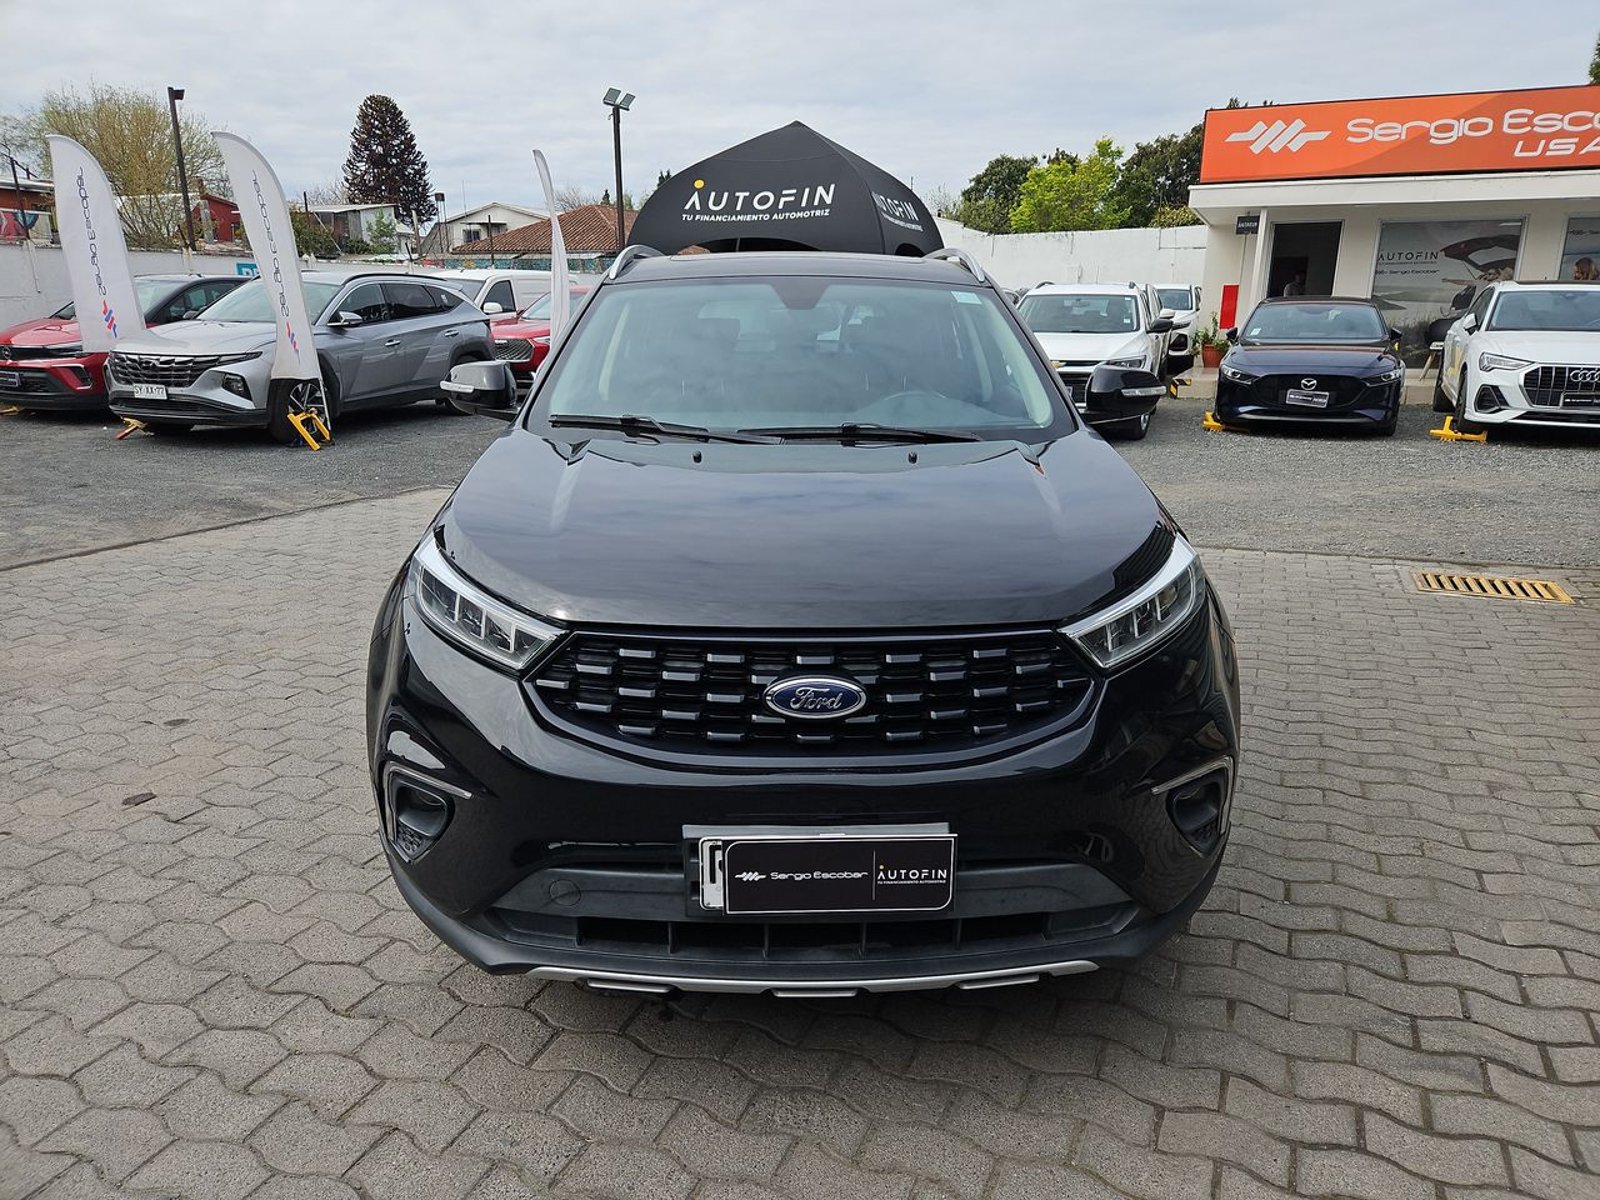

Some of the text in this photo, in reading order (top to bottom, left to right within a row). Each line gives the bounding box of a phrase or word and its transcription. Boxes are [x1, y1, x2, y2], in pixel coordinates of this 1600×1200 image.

[1346, 108, 1600, 145] Sergio Esc
[684, 181, 835, 211] AUTOFIN
[695, 214, 770, 222] FINANCIAMIENTO
[772, 209, 831, 220] AUTOMOTRIZ
[1378, 251, 1438, 261] AUTOFIN
[789, 687, 843, 709] Ford
[770, 871, 868, 881] Sergio Escobar
[877, 867, 947, 880] AUTOFIN
